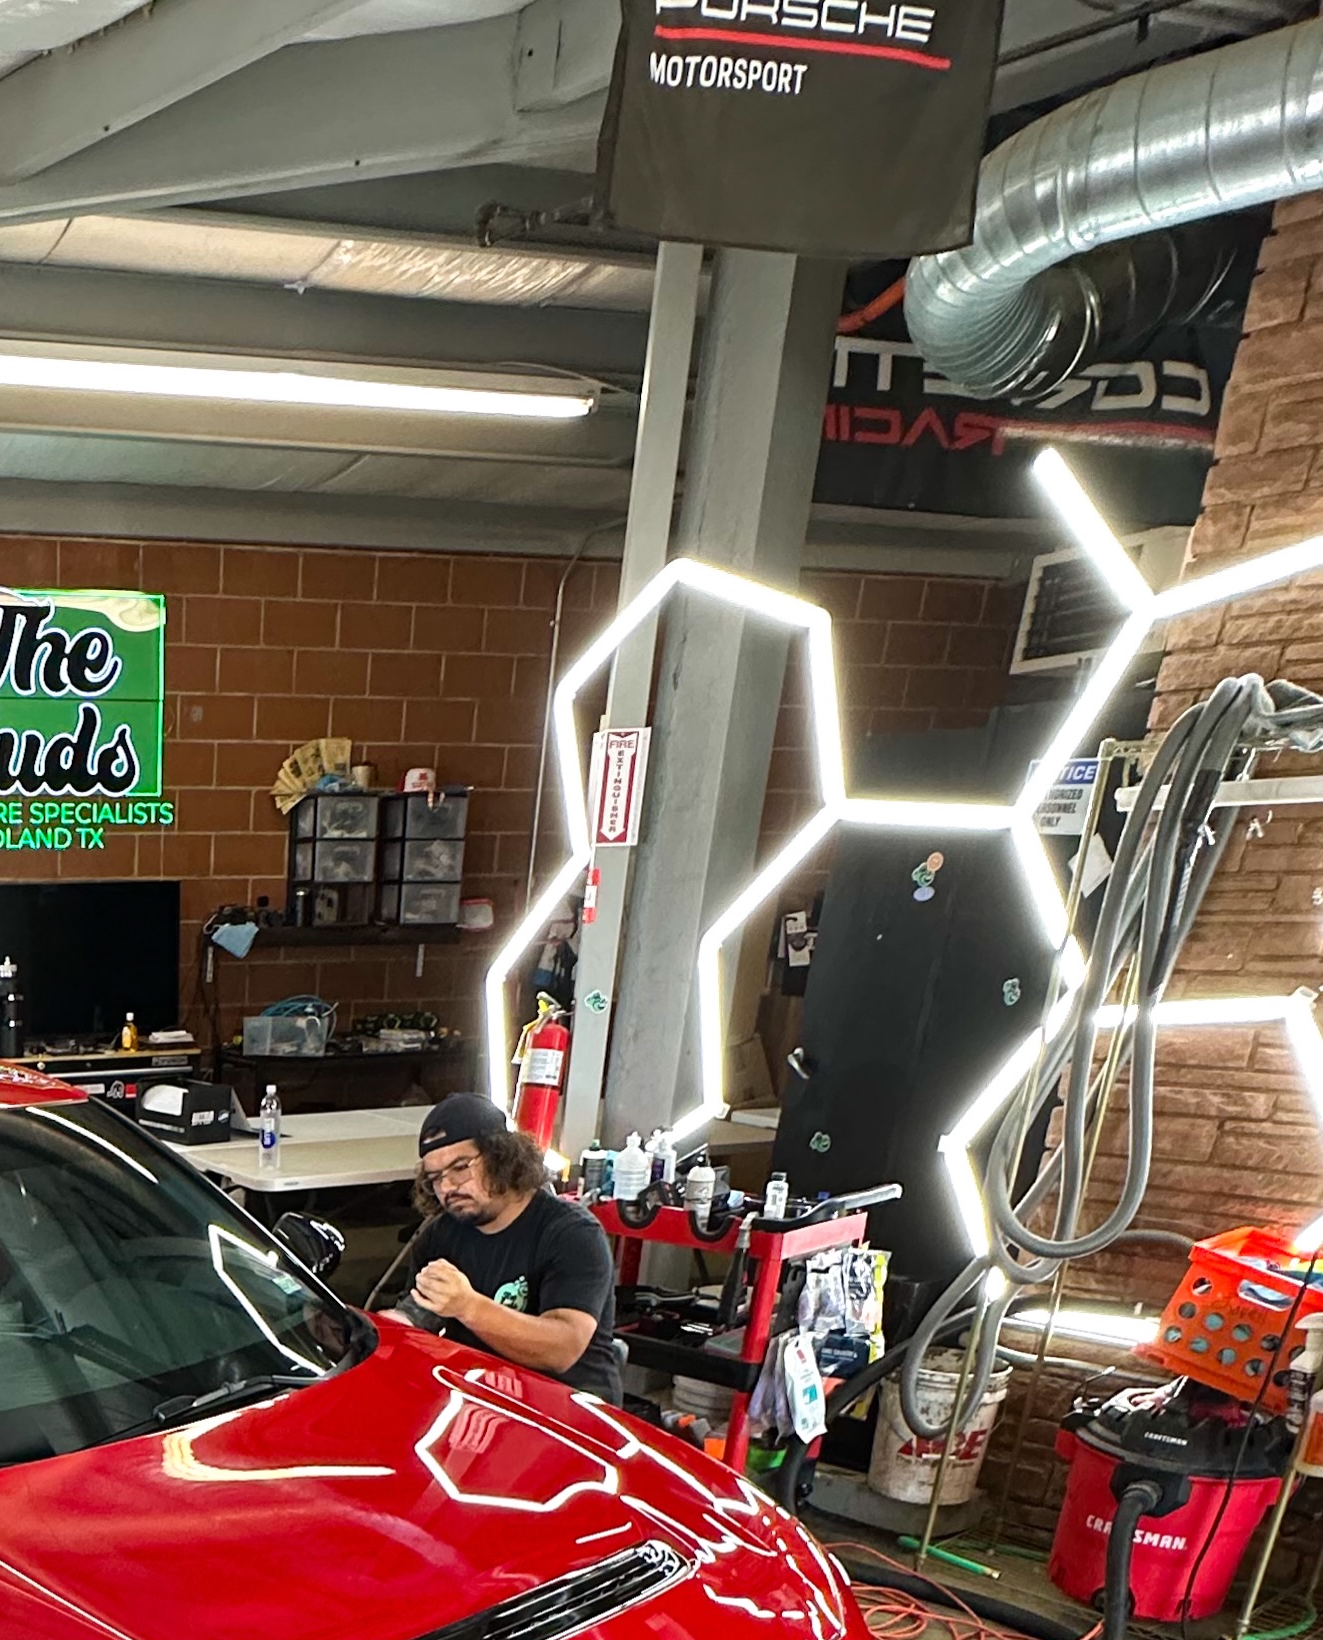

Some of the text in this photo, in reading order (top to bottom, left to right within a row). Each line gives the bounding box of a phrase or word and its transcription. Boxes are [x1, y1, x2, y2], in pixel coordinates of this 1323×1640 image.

[650, 51, 808, 95] MOTORSPORT
[609, 739, 634, 749] FIRE
[608, 750, 625, 833] EXTINGUISHER
[28, 802, 174, 825] SPECIALISTS
[75, 828, 105, 849] TX
[1143, 1431, 1188, 1446] CRAFTSMAN
[1085, 1514, 1188, 1551] CRASMAN
